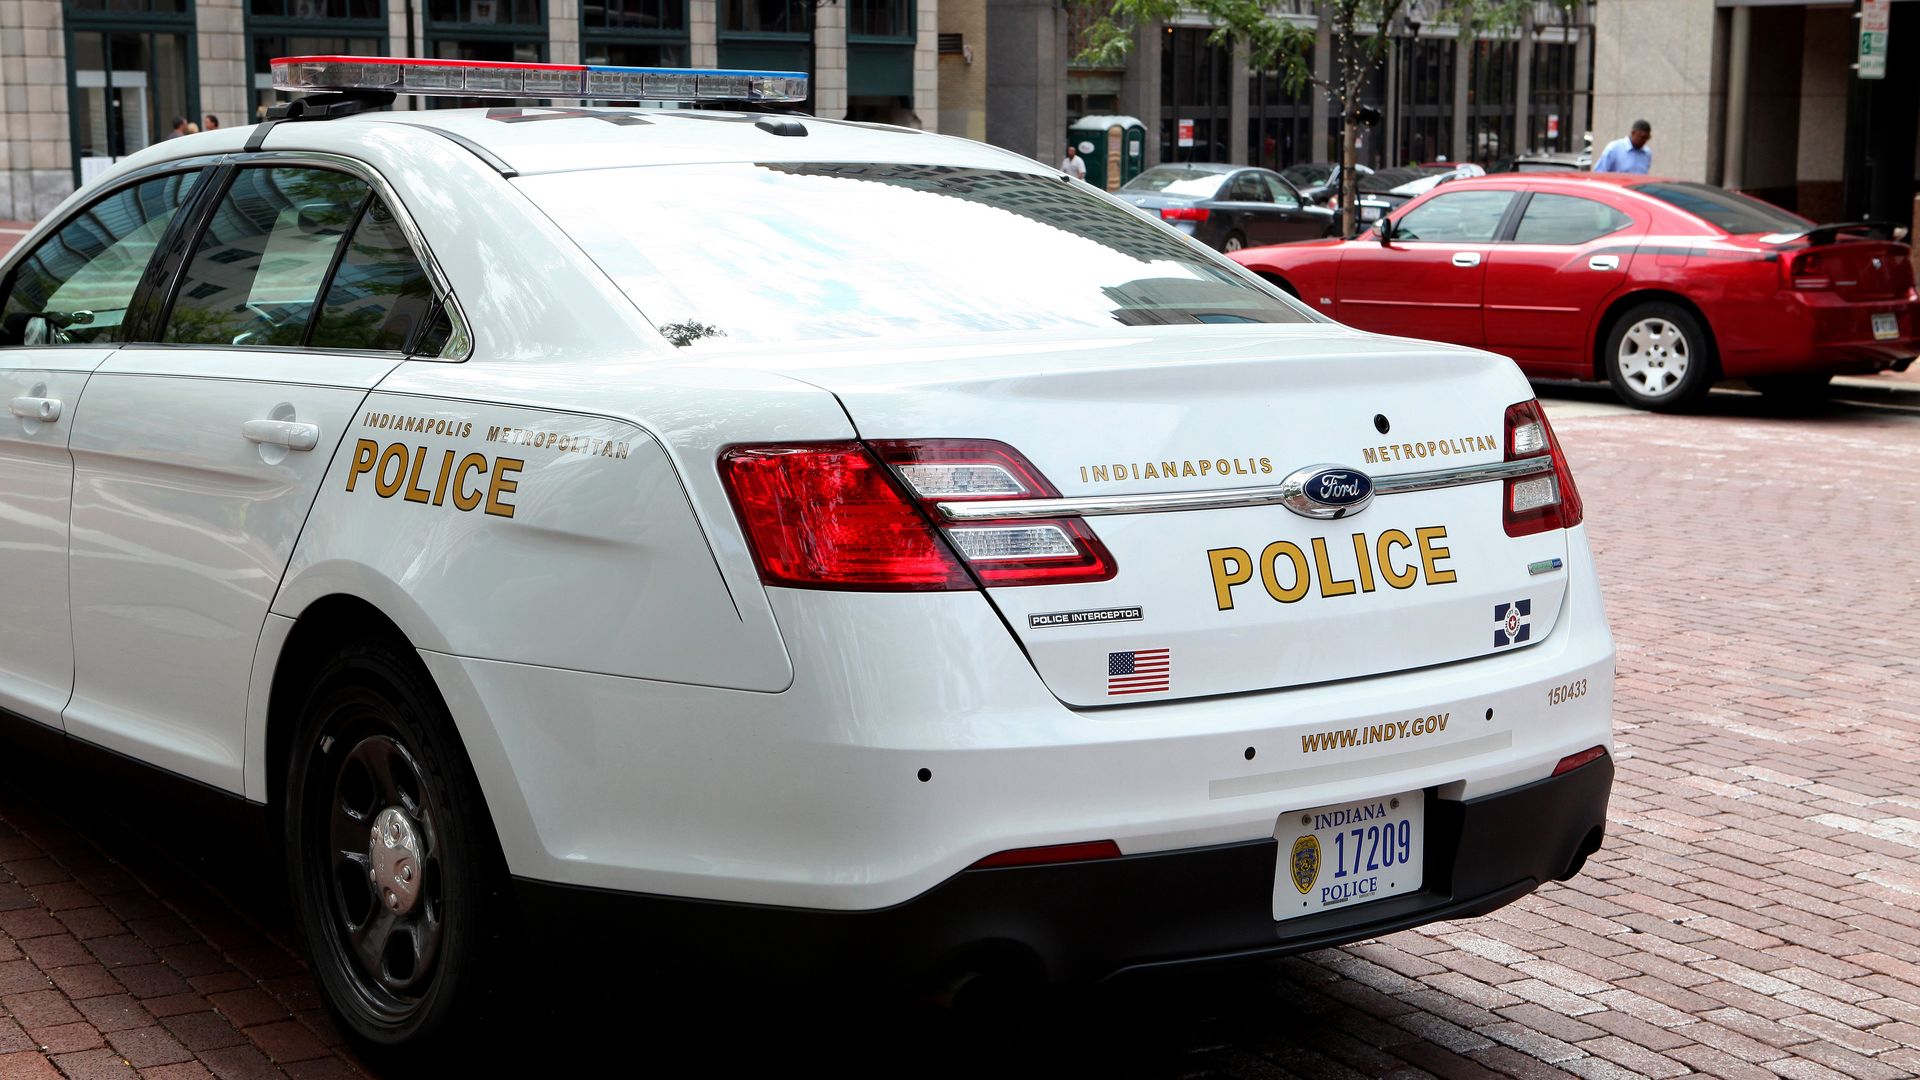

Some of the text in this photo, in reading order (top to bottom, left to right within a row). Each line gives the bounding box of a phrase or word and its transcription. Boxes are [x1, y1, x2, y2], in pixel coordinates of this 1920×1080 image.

[363, 412, 630, 460] INDIANAPOLIS METROPOLITAN
[1080, 434, 1497, 482] INDIANAPOLIS METROPOLITAN
[345, 438, 524, 519] POLICE
[1320, 474, 1360, 498] Ford
[1206, 525, 1458, 611] POLICE
[1032, 608, 1140, 625] POLICE INTERCEPTOR
[1547, 678, 1588, 707] 150433
[1301, 713, 1450, 753] WWW.INDY.GOV
[1314, 802, 1387, 830] INDIANA
[1334, 819, 1411, 878] 17209
[1321, 877, 1378, 902] POLICE
